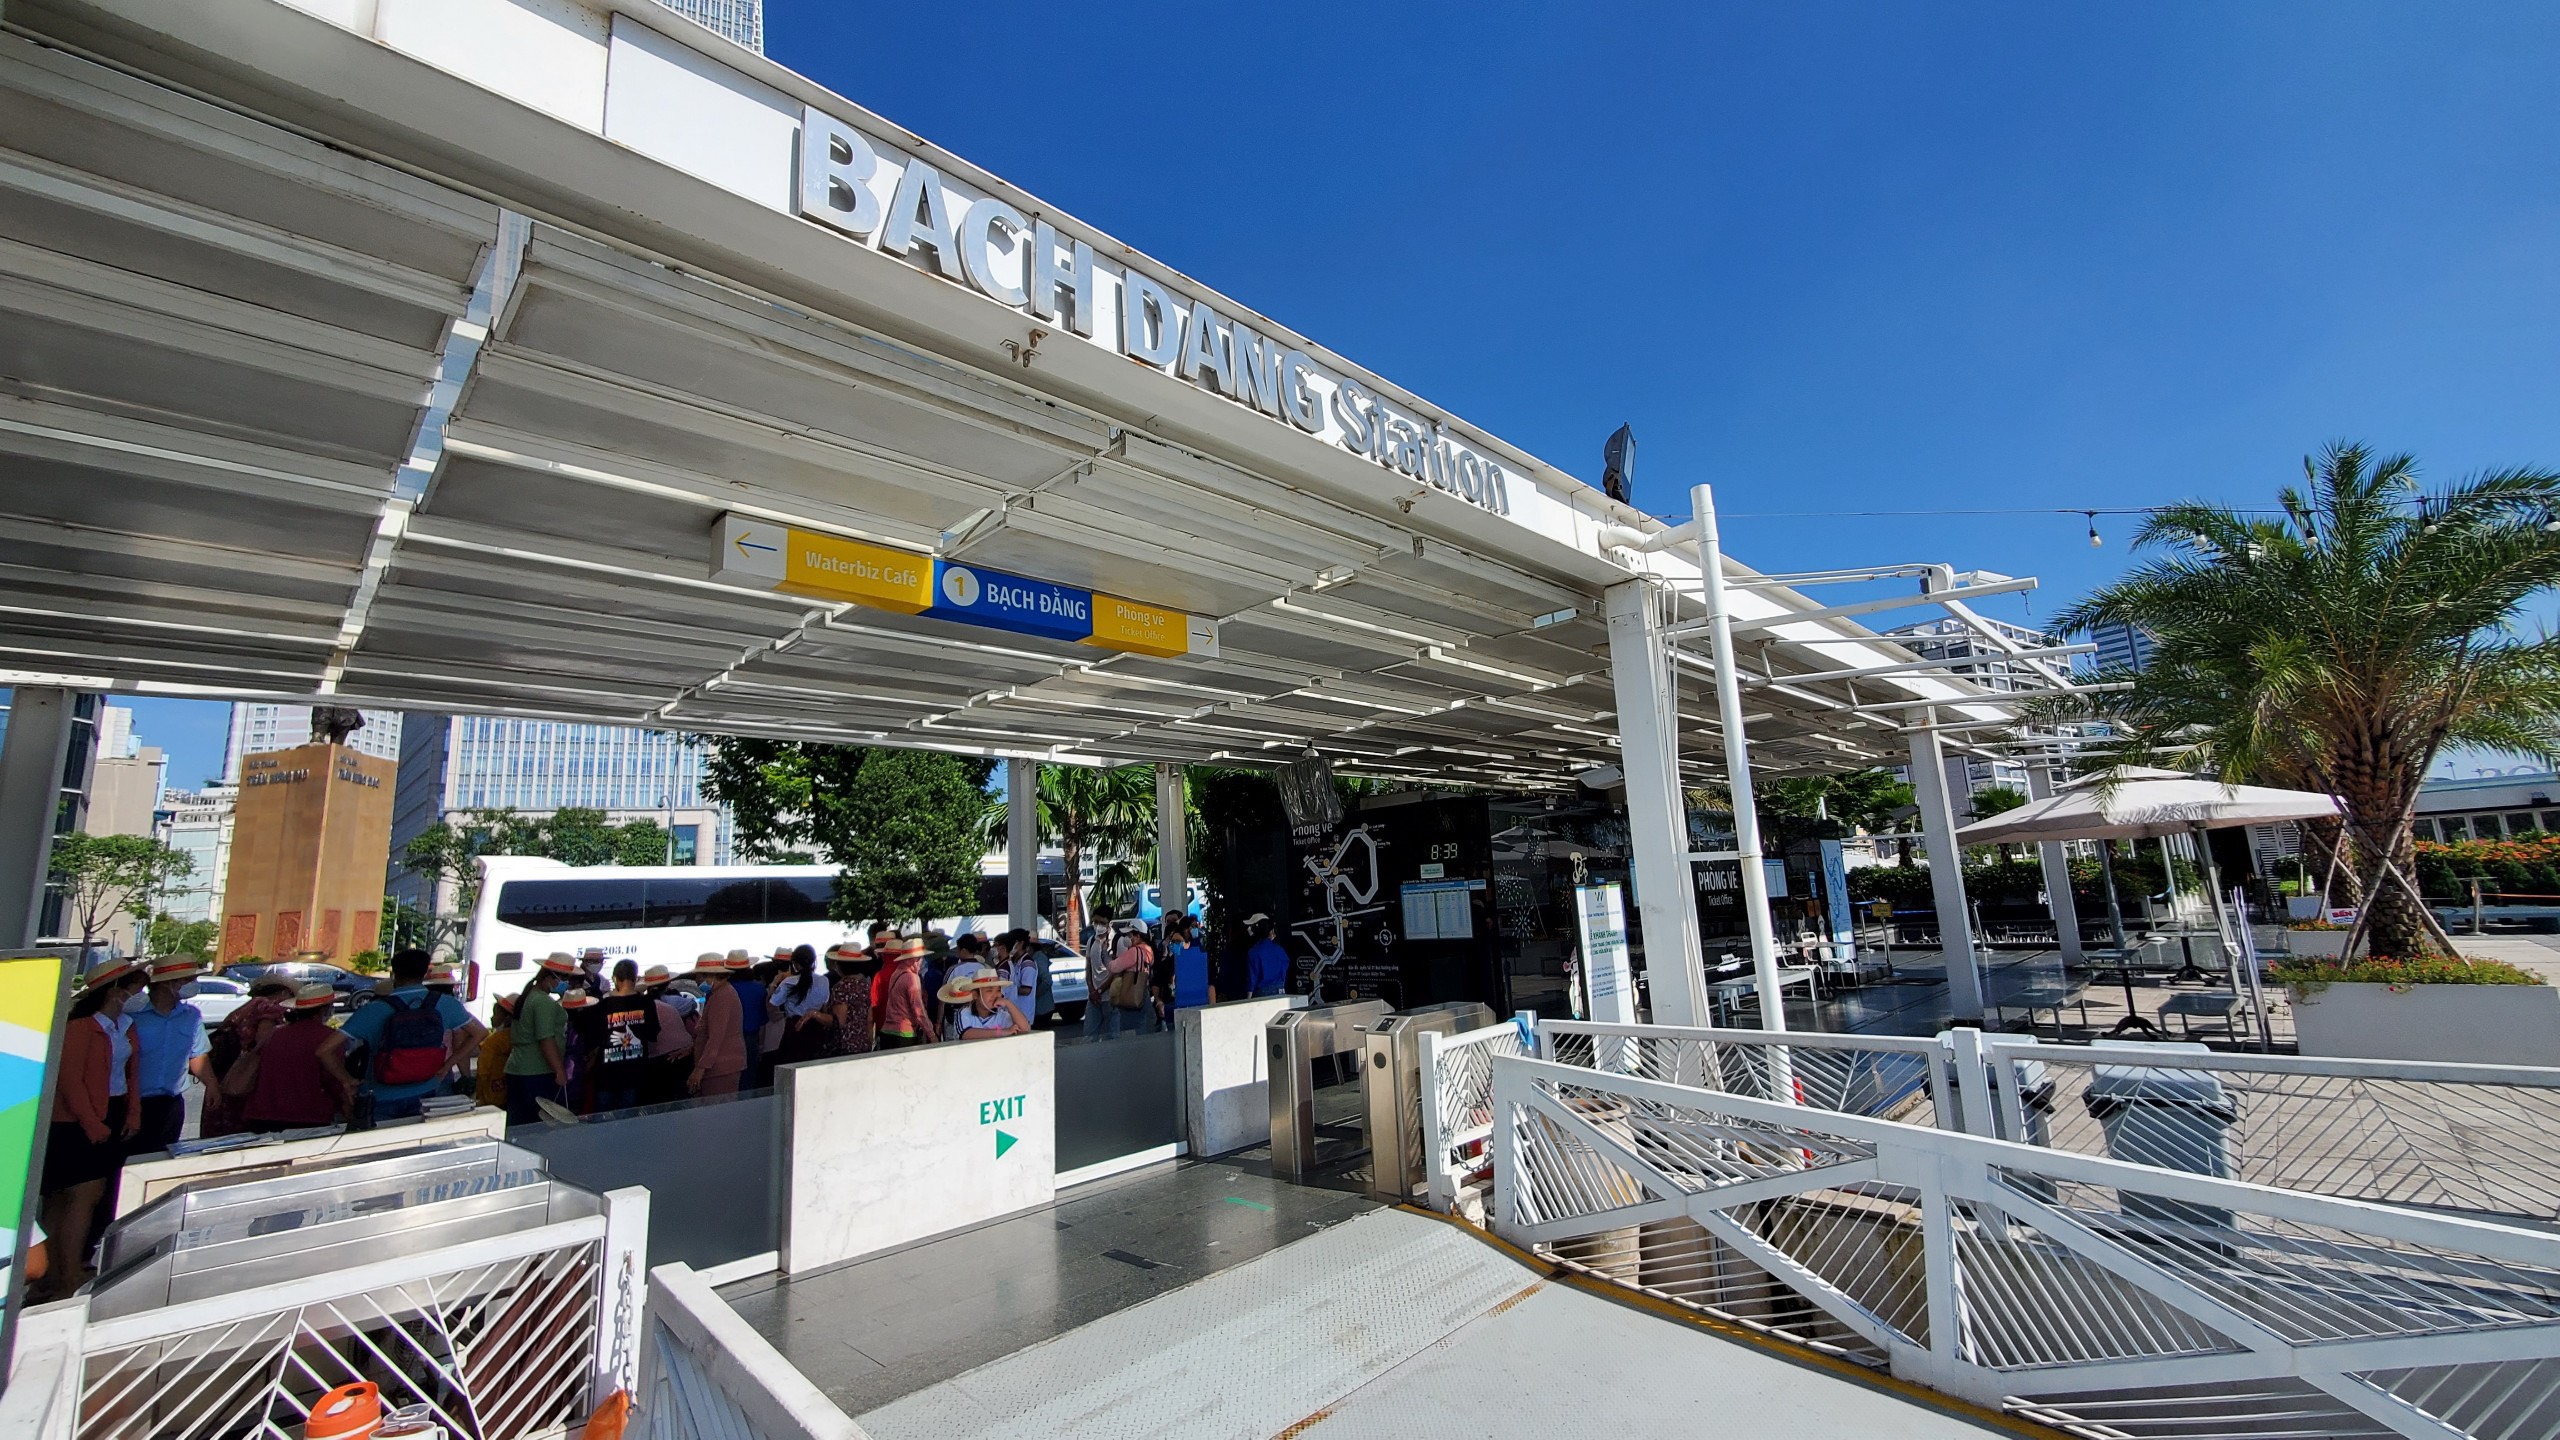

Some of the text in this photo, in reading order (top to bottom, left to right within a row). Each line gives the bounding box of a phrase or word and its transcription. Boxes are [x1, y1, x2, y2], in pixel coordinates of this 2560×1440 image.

[798, 104, 1511, 517] BACH DANG Station
[805, 550, 918, 588] Waterbiz Café
[953, 576, 965, 597] 1
[987, 582, 1087, 621] BẠCH ĐẰNG
[1116, 605, 1151, 627] Phòng
[1121, 624, 1166, 643] Ticket Office
[1431, 842, 1459, 861] 8:39
[1697, 865, 1728, 892] PHÒNG
[1726, 864, 1739, 889] VÉ
[979, 1094, 1027, 1126] EXIT
